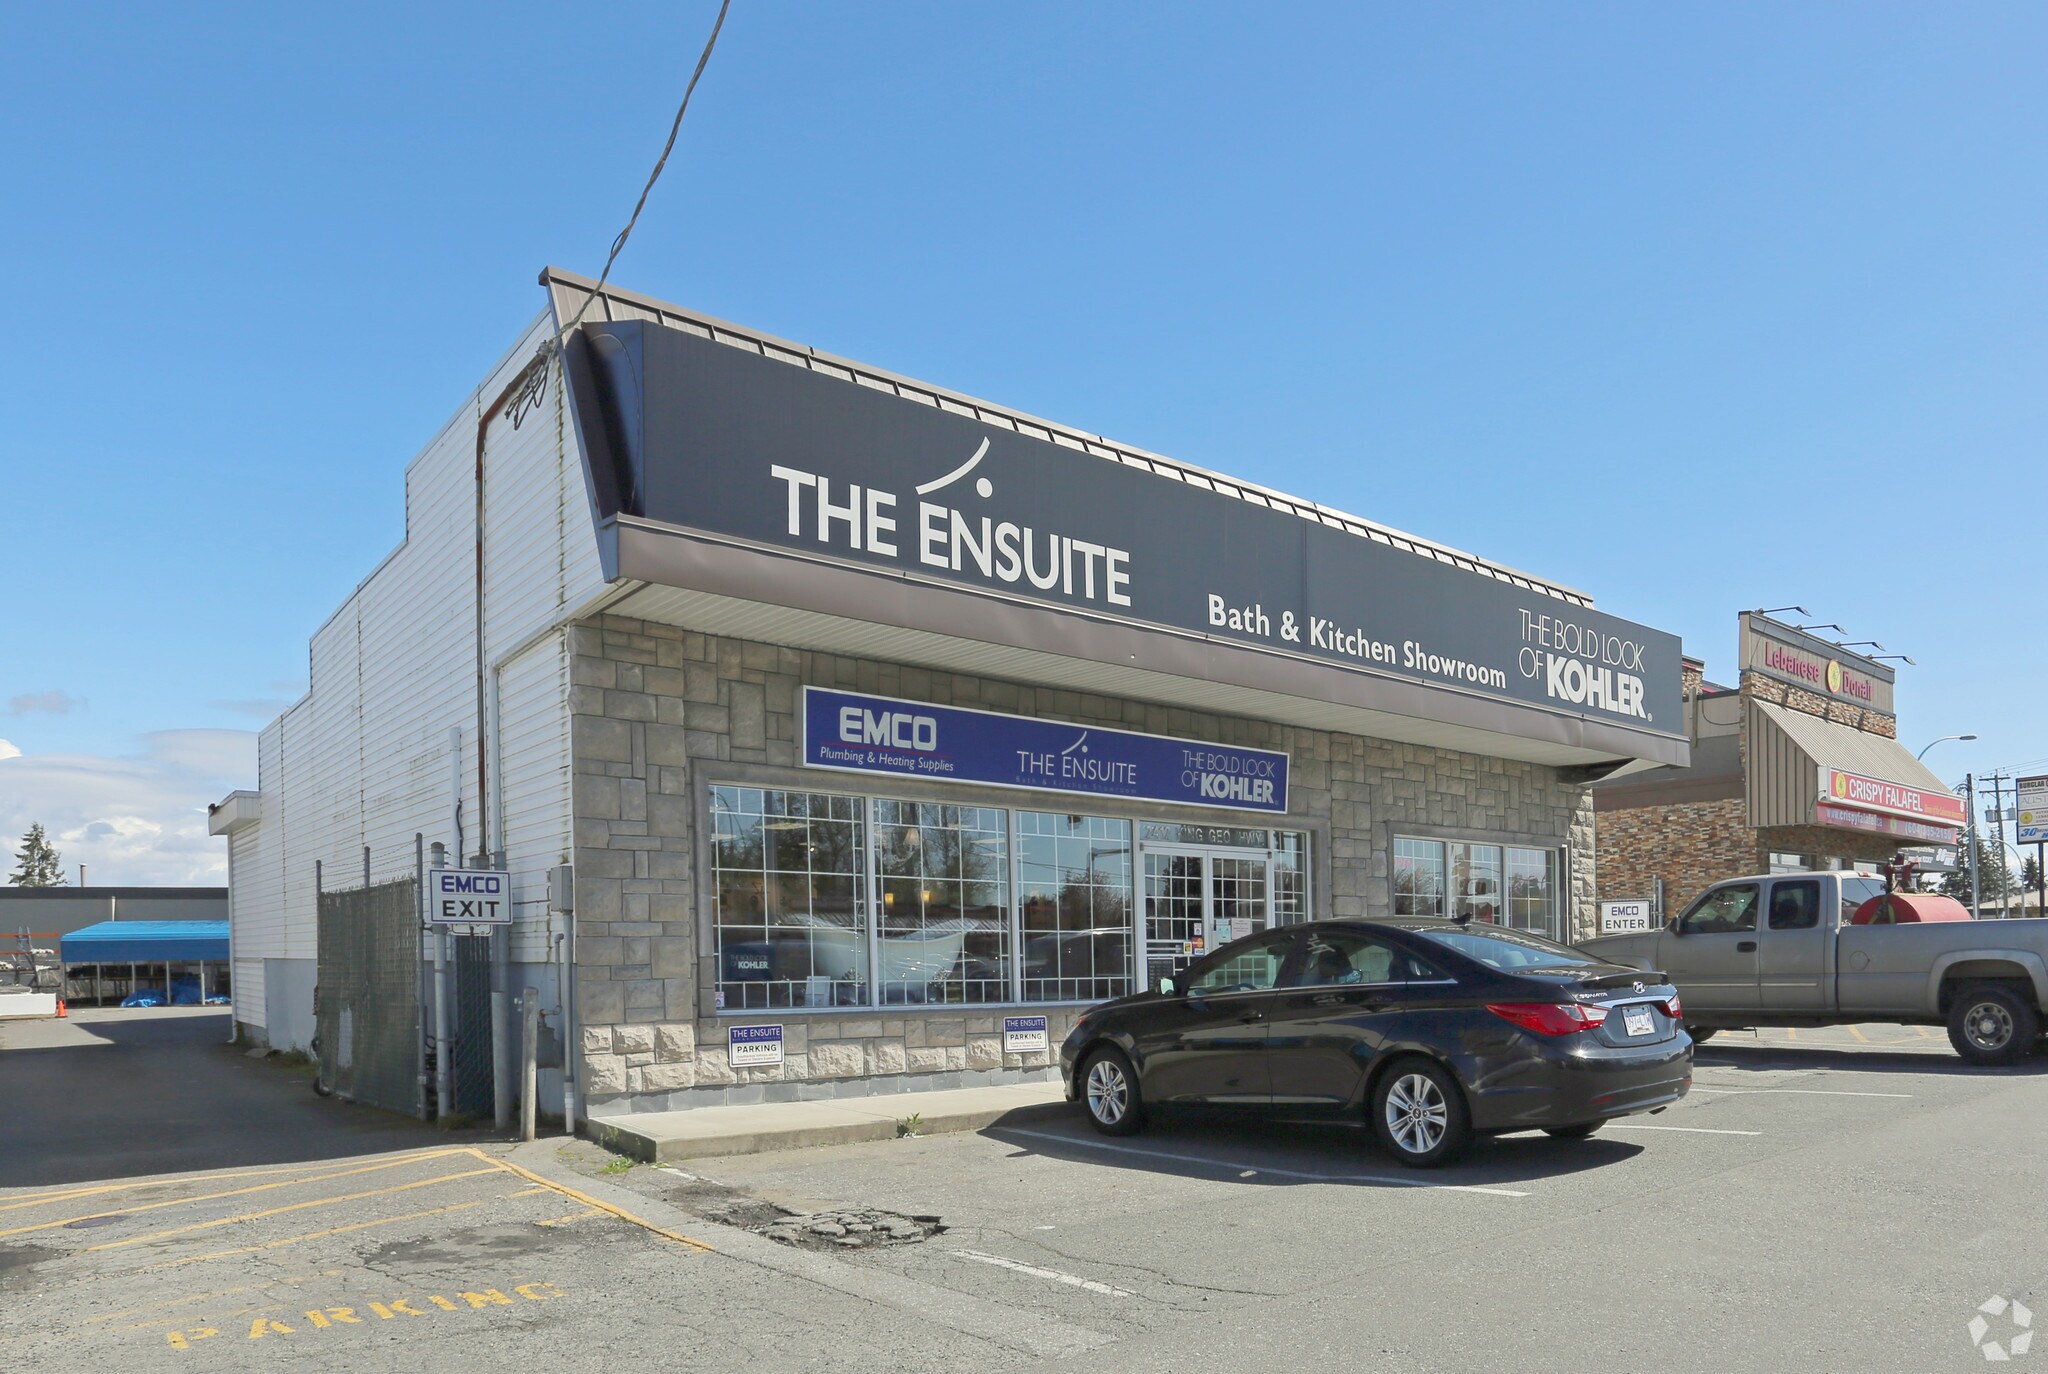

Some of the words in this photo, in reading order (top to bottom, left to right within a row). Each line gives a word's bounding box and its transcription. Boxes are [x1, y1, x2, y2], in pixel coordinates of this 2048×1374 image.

[771, 464, 897, 557] THE
[920, 501, 1131, 606] ENSUITE
[1208, 593, 1270, 637] Bath
[1280, 610, 1301, 642] &
[1310, 616, 1397, 664] Kitchen
[1403, 640, 1506, 689] Showroom
[1518, 608, 1550, 646] THE
[1554, 619, 1599, 659] BOLD
[1603, 634, 1645, 673] LOOK
[1765, 641, 1820, 682] Lebanese
[1518, 647, 1544, 680] OF
[1546, 653, 1647, 719] KOHLER
[840, 706, 937, 751] EMCO
[820, 746, 864, 765] Plumbing
[867, 752, 875, 763] &
[879, 753, 915, 770] Heating
[918, 757, 954, 772] Supplies
[1017, 751, 1055, 775] THE
[1062, 756, 1137, 785] ENSUITE
[1183, 750, 1204, 769] THE
[1207, 753, 1240, 773] BOLD
[1243, 758, 1275, 778] LOOK
[1181, 770, 1199, 788] OF
[1201, 773, 1274, 804] KOHLER
[1849, 778, 1884, 803] CRISPY
[1885, 786, 1924, 812] FALAFEL
[1208, 829, 1231, 843] GEO
[441, 876, 500, 893] EMCO
[442, 900, 500, 917] EXIT
[1611, 906, 1639, 916] EMCO
[1606, 919, 1645, 929] ENTER
[738, 961, 769, 969] KOHLER
[732, 1029, 748, 1038] THE
[750, 1028, 780, 1037] ENSUITE
[1006, 1019, 1019, 1027] THE
[1020, 1019, 1044, 1027] ENSUITE
[737, 1044, 777, 1053] PARKING
[166, 1282, 567, 1350] PARKING
